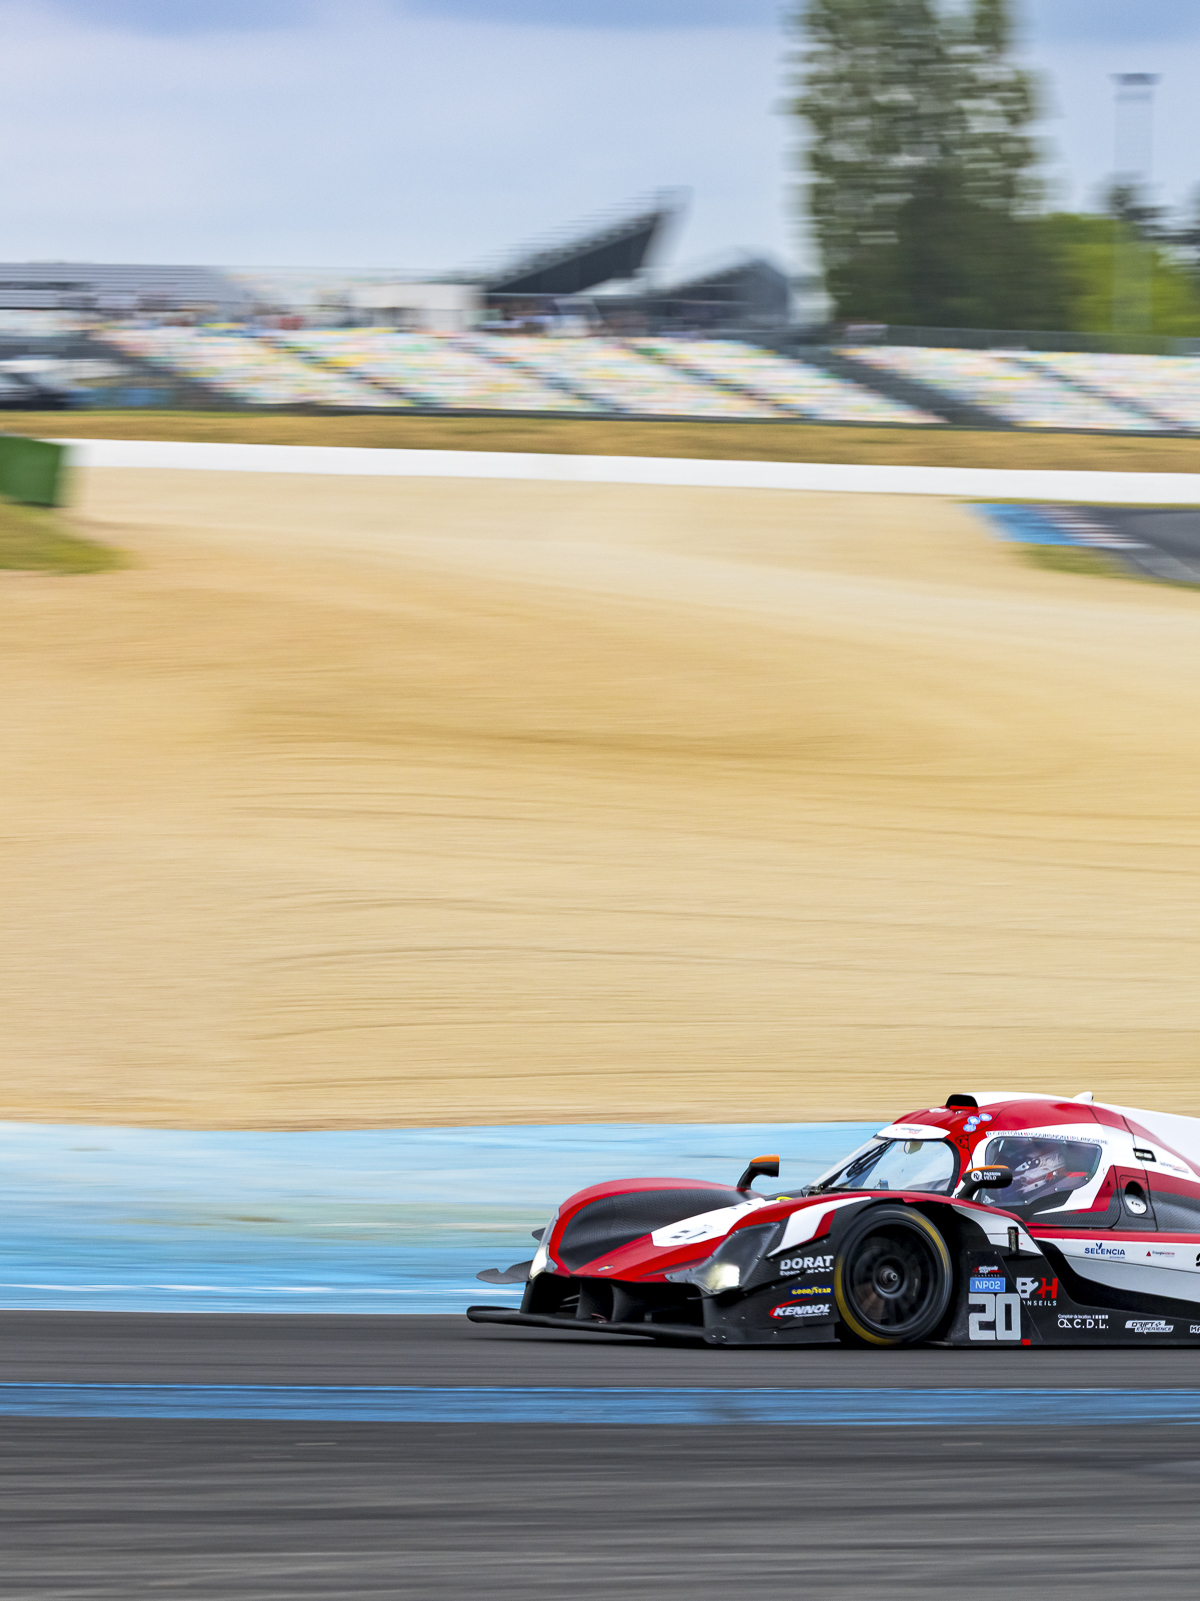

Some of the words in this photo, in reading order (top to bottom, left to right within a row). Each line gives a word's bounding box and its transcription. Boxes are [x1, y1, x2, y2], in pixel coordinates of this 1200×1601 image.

[1084, 1247, 1126, 1256] SELENCIA
[780, 1255, 834, 1270] DORAT
[975, 1280, 1001, 1290] NP02
[773, 1303, 831, 1317] KENNOL
[968, 1293, 1021, 1341] 20
[1073, 1319, 1109, 1329] C.D.L.
